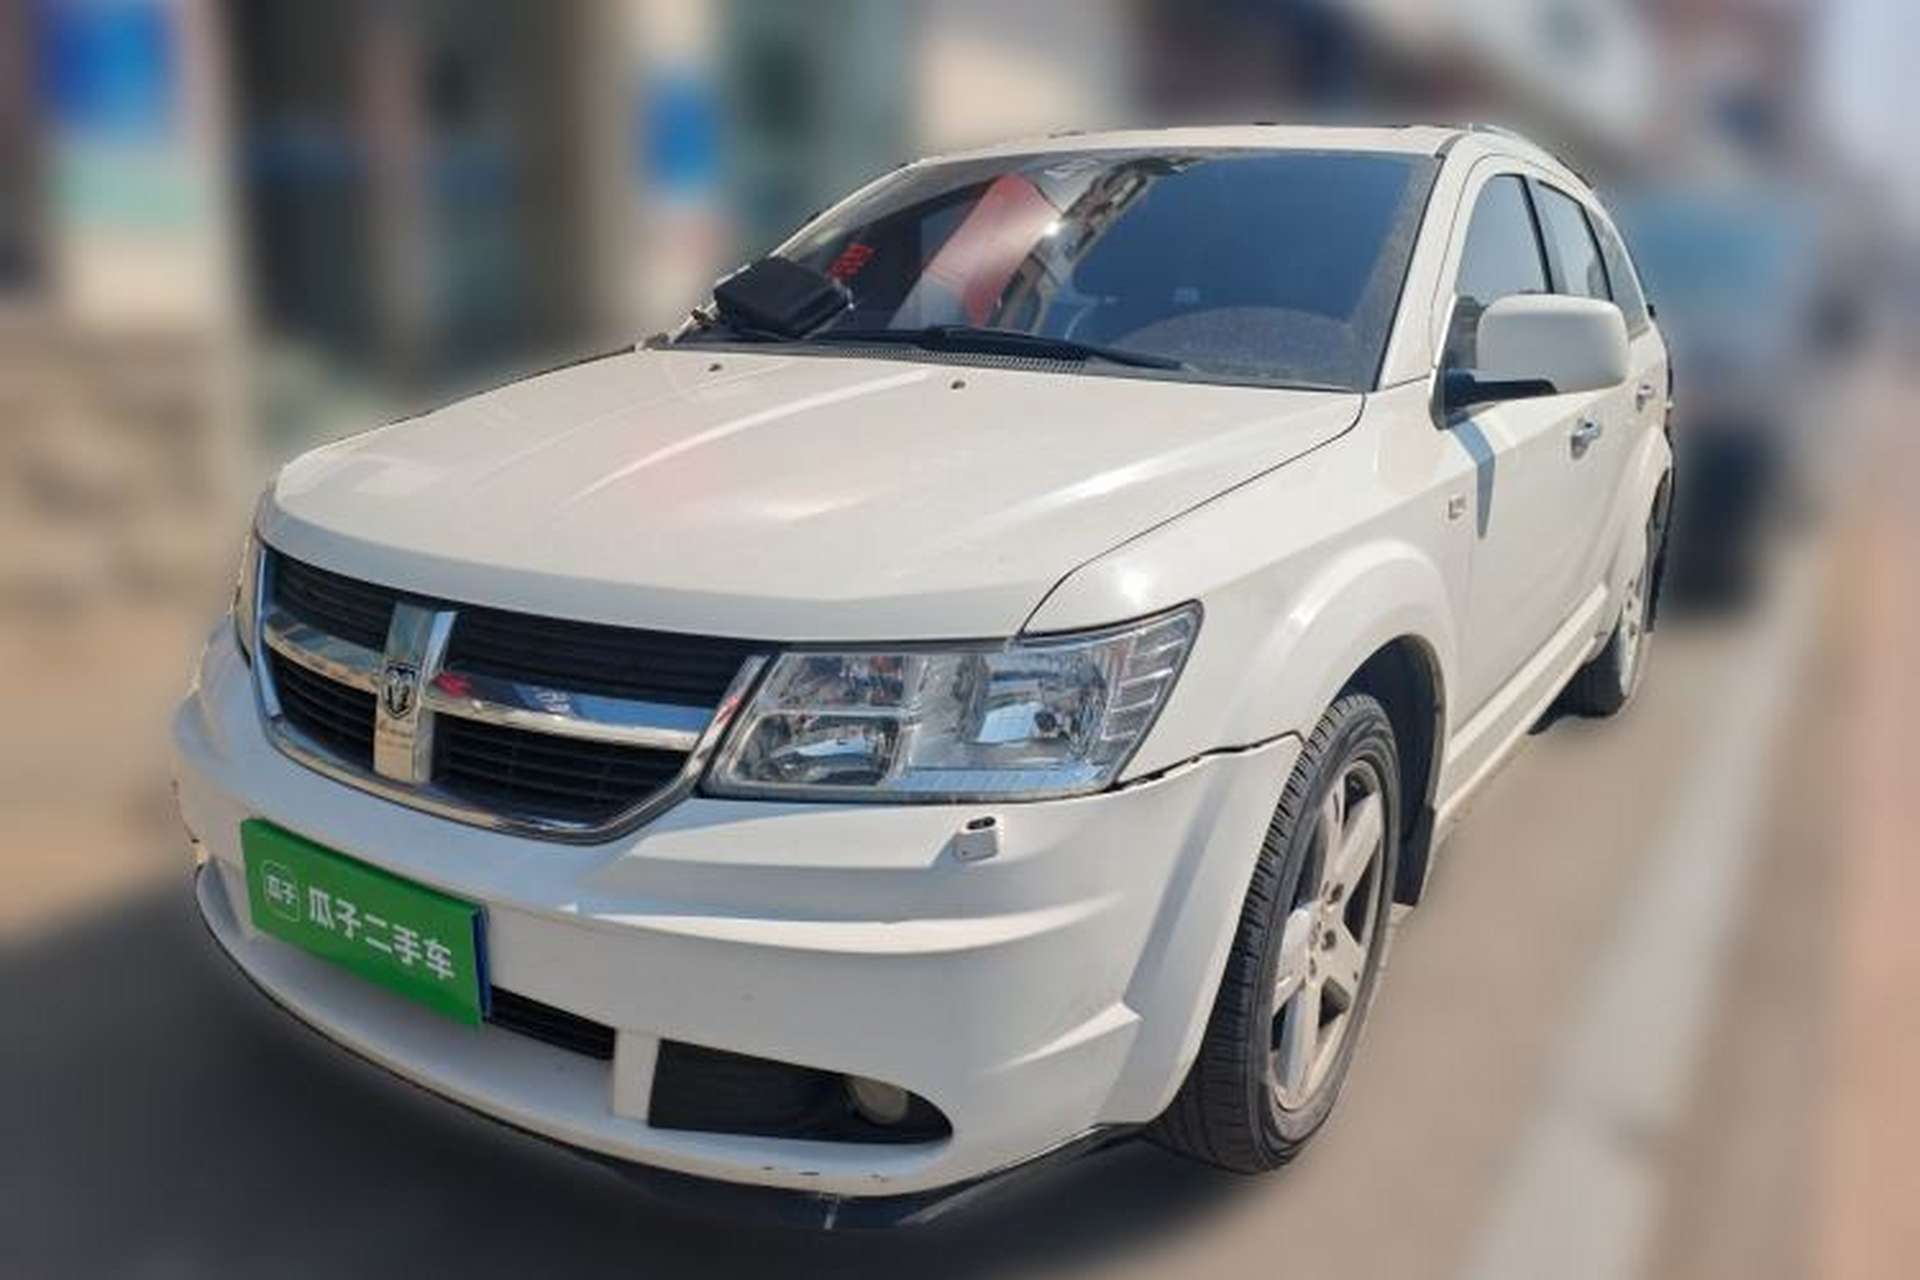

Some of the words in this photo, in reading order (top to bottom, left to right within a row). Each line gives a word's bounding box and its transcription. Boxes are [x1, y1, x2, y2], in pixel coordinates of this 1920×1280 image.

[308, 886, 455, 980] 瓜子二手车
